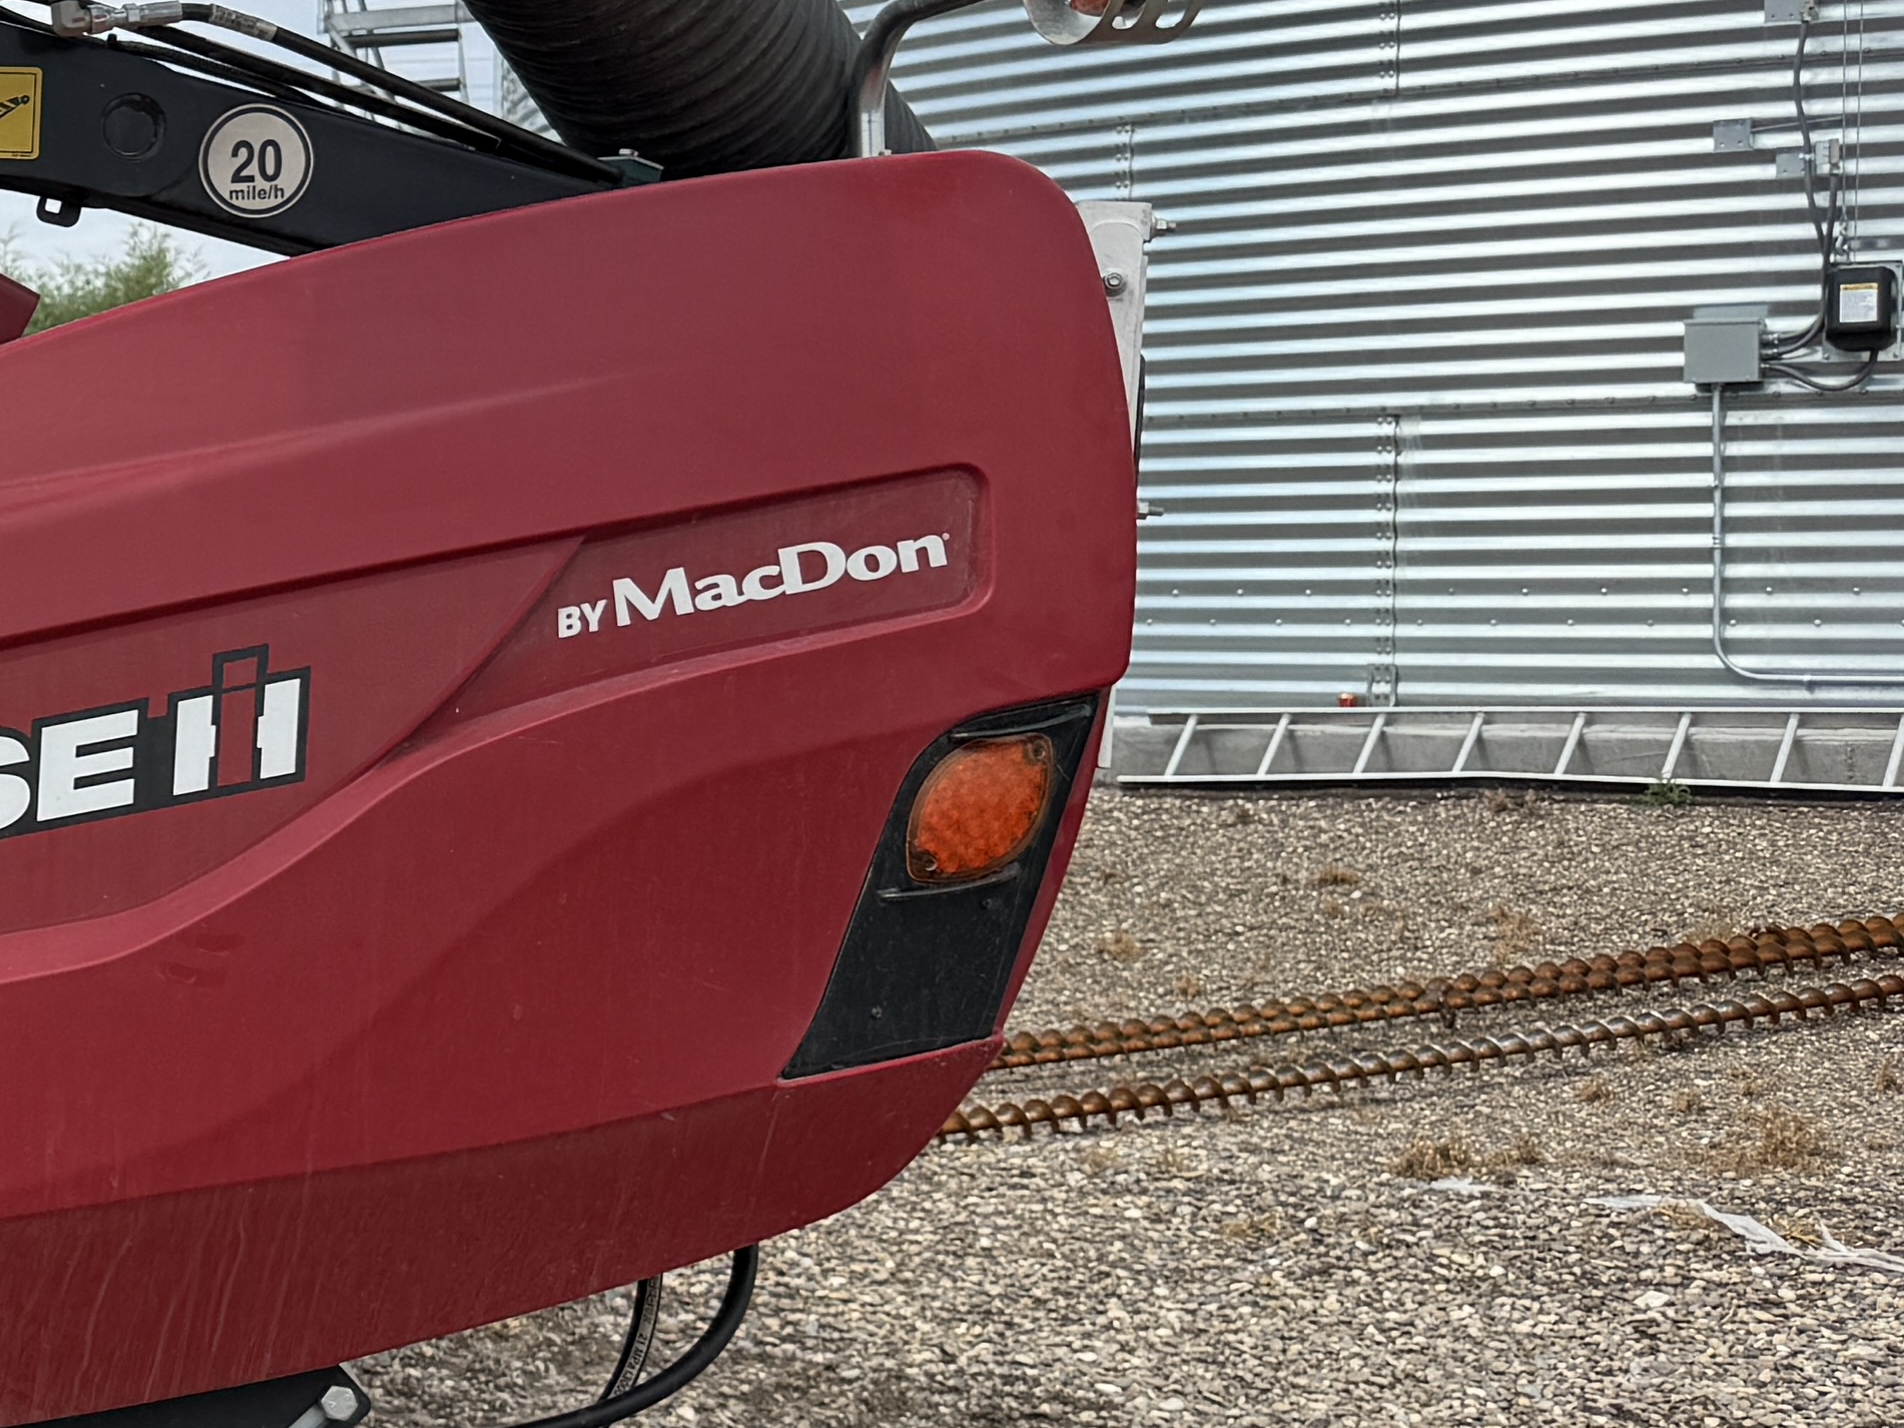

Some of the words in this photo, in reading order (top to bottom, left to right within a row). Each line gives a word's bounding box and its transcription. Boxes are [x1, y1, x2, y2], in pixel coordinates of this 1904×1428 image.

[230, 139, 283, 184] 20
[229, 184, 285, 201] mile/h
[557, 599, 608, 639] BY
[169, 646, 308, 798] IH
